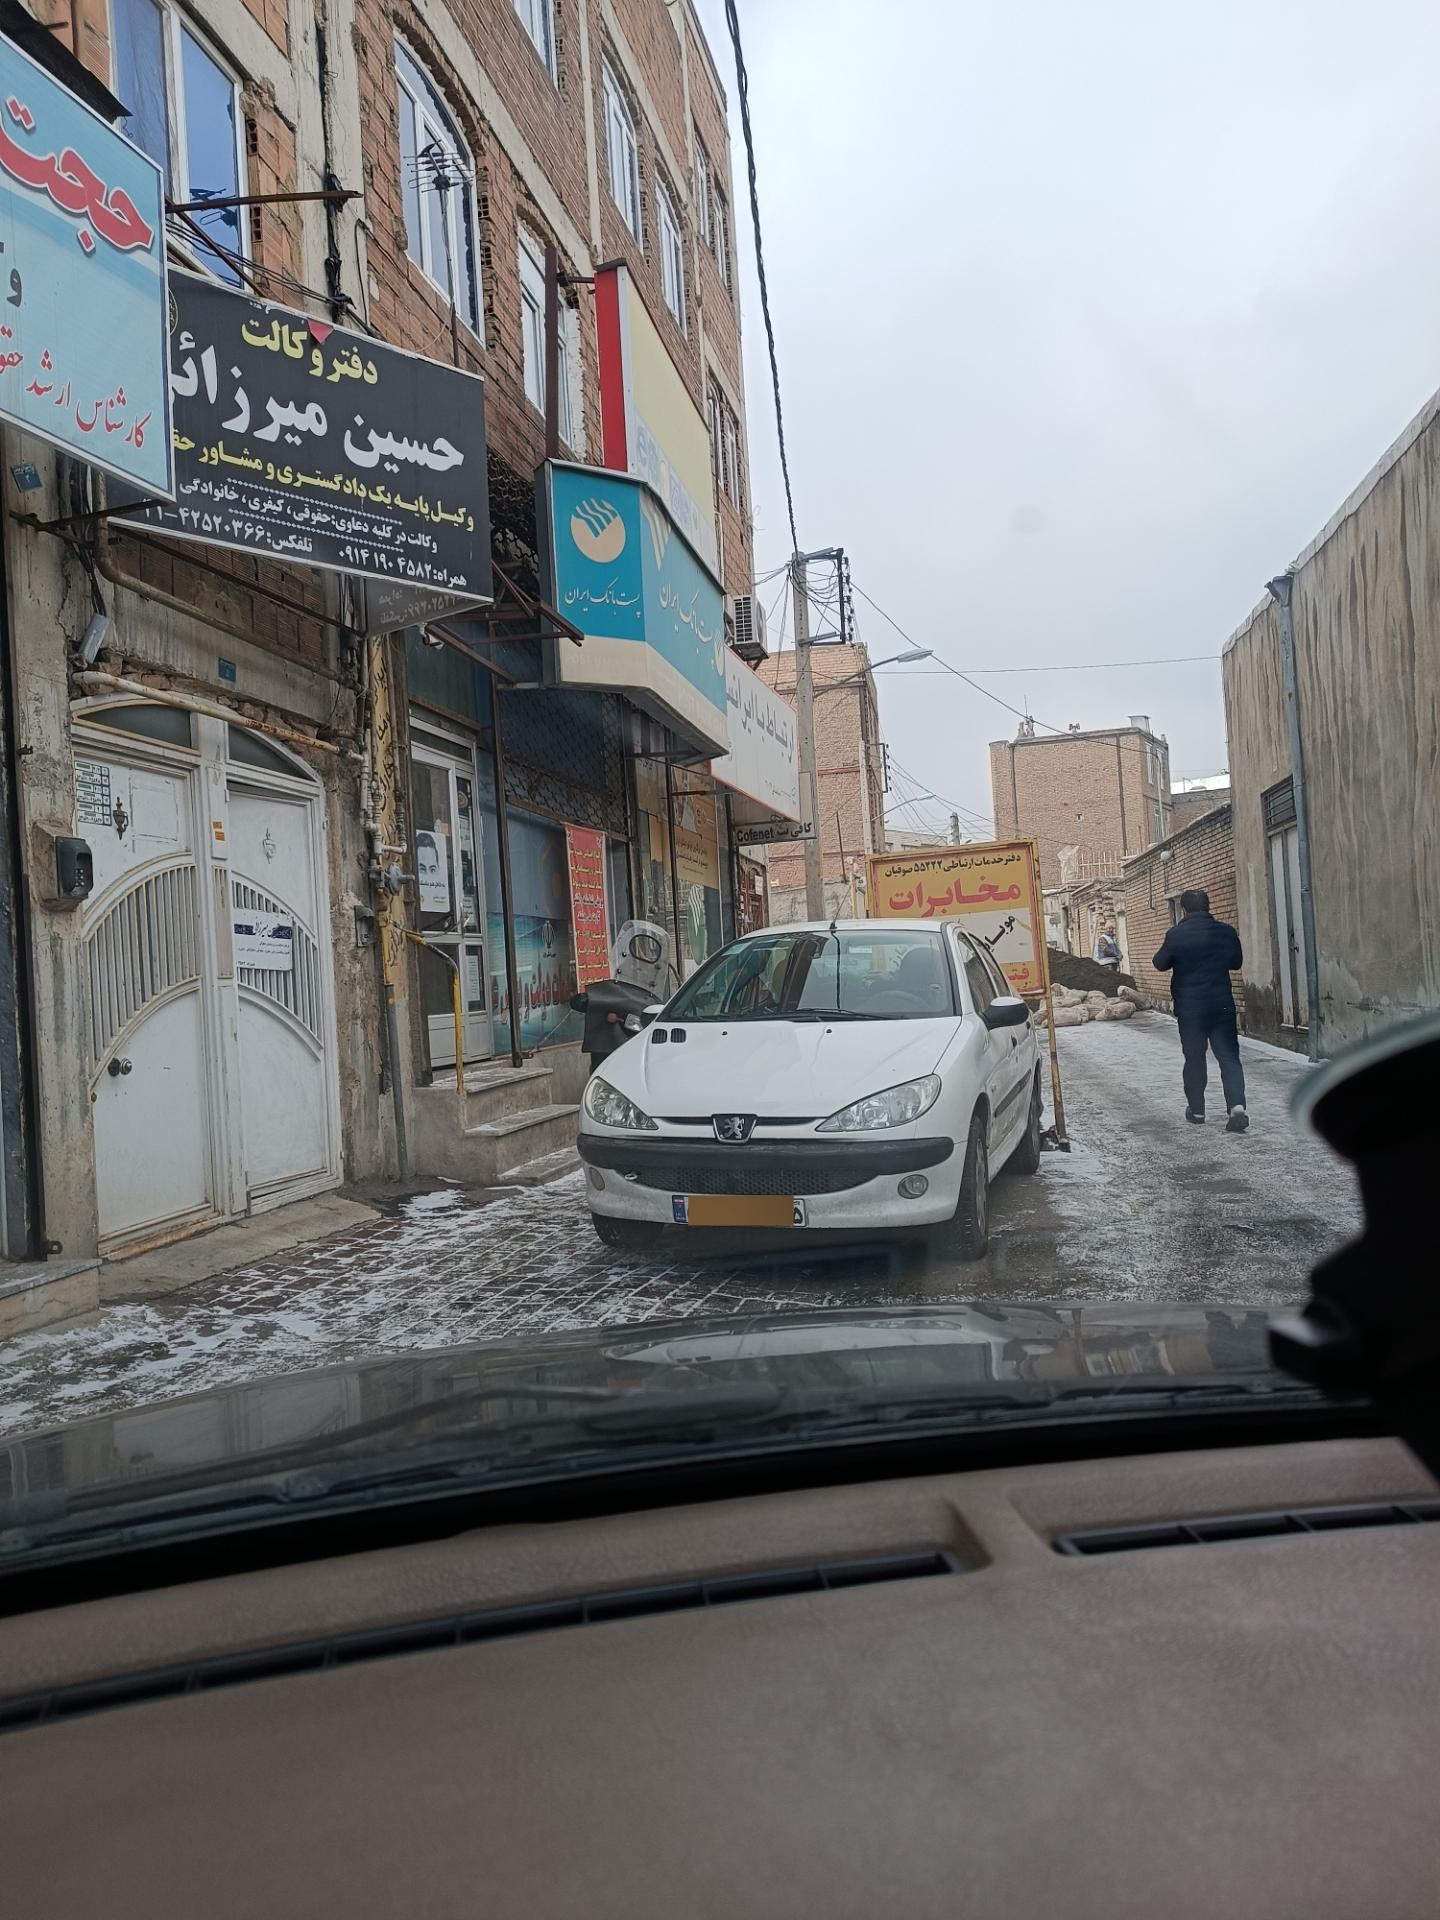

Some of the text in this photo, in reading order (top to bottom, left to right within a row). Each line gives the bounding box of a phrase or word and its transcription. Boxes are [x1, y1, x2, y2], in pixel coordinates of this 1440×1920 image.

[0, 95, 153, 252] حجت
[241, 320, 378, 385] دفتر وکالت
[26, 350, 71, 407] ارشد
[171, 331, 464, 474] حسین میرزائ
[75, 387, 152, 448] کارشناس
[198, 441, 263, 470] مشاور
[265, 462, 275, 480] و
[277, 466, 367, 498] دادگستری
[179, 478, 239, 502] خانوادگی
[368, 485, 393, 510] یک
[394, 494, 430, 522] پایه
[430, 501, 474, 532] وکیل
[372, 524, 392, 540] کلیه
[395, 531, 407, 545] در
[408, 534, 438, 553] وکالت
[564, 576, 641, 619] پست بانک ایران
[765, 703, 794, 764] ارتباط
[736, 827, 775, 843] Cofenet
[790, 822, 813, 839] کافی
[943, 858, 974, 872] ارتباطی
[974, 855, 1004, 868] خدمات
[1004, 853, 1022, 866] دفتر
[889, 875, 1021, 917] مخابرات
